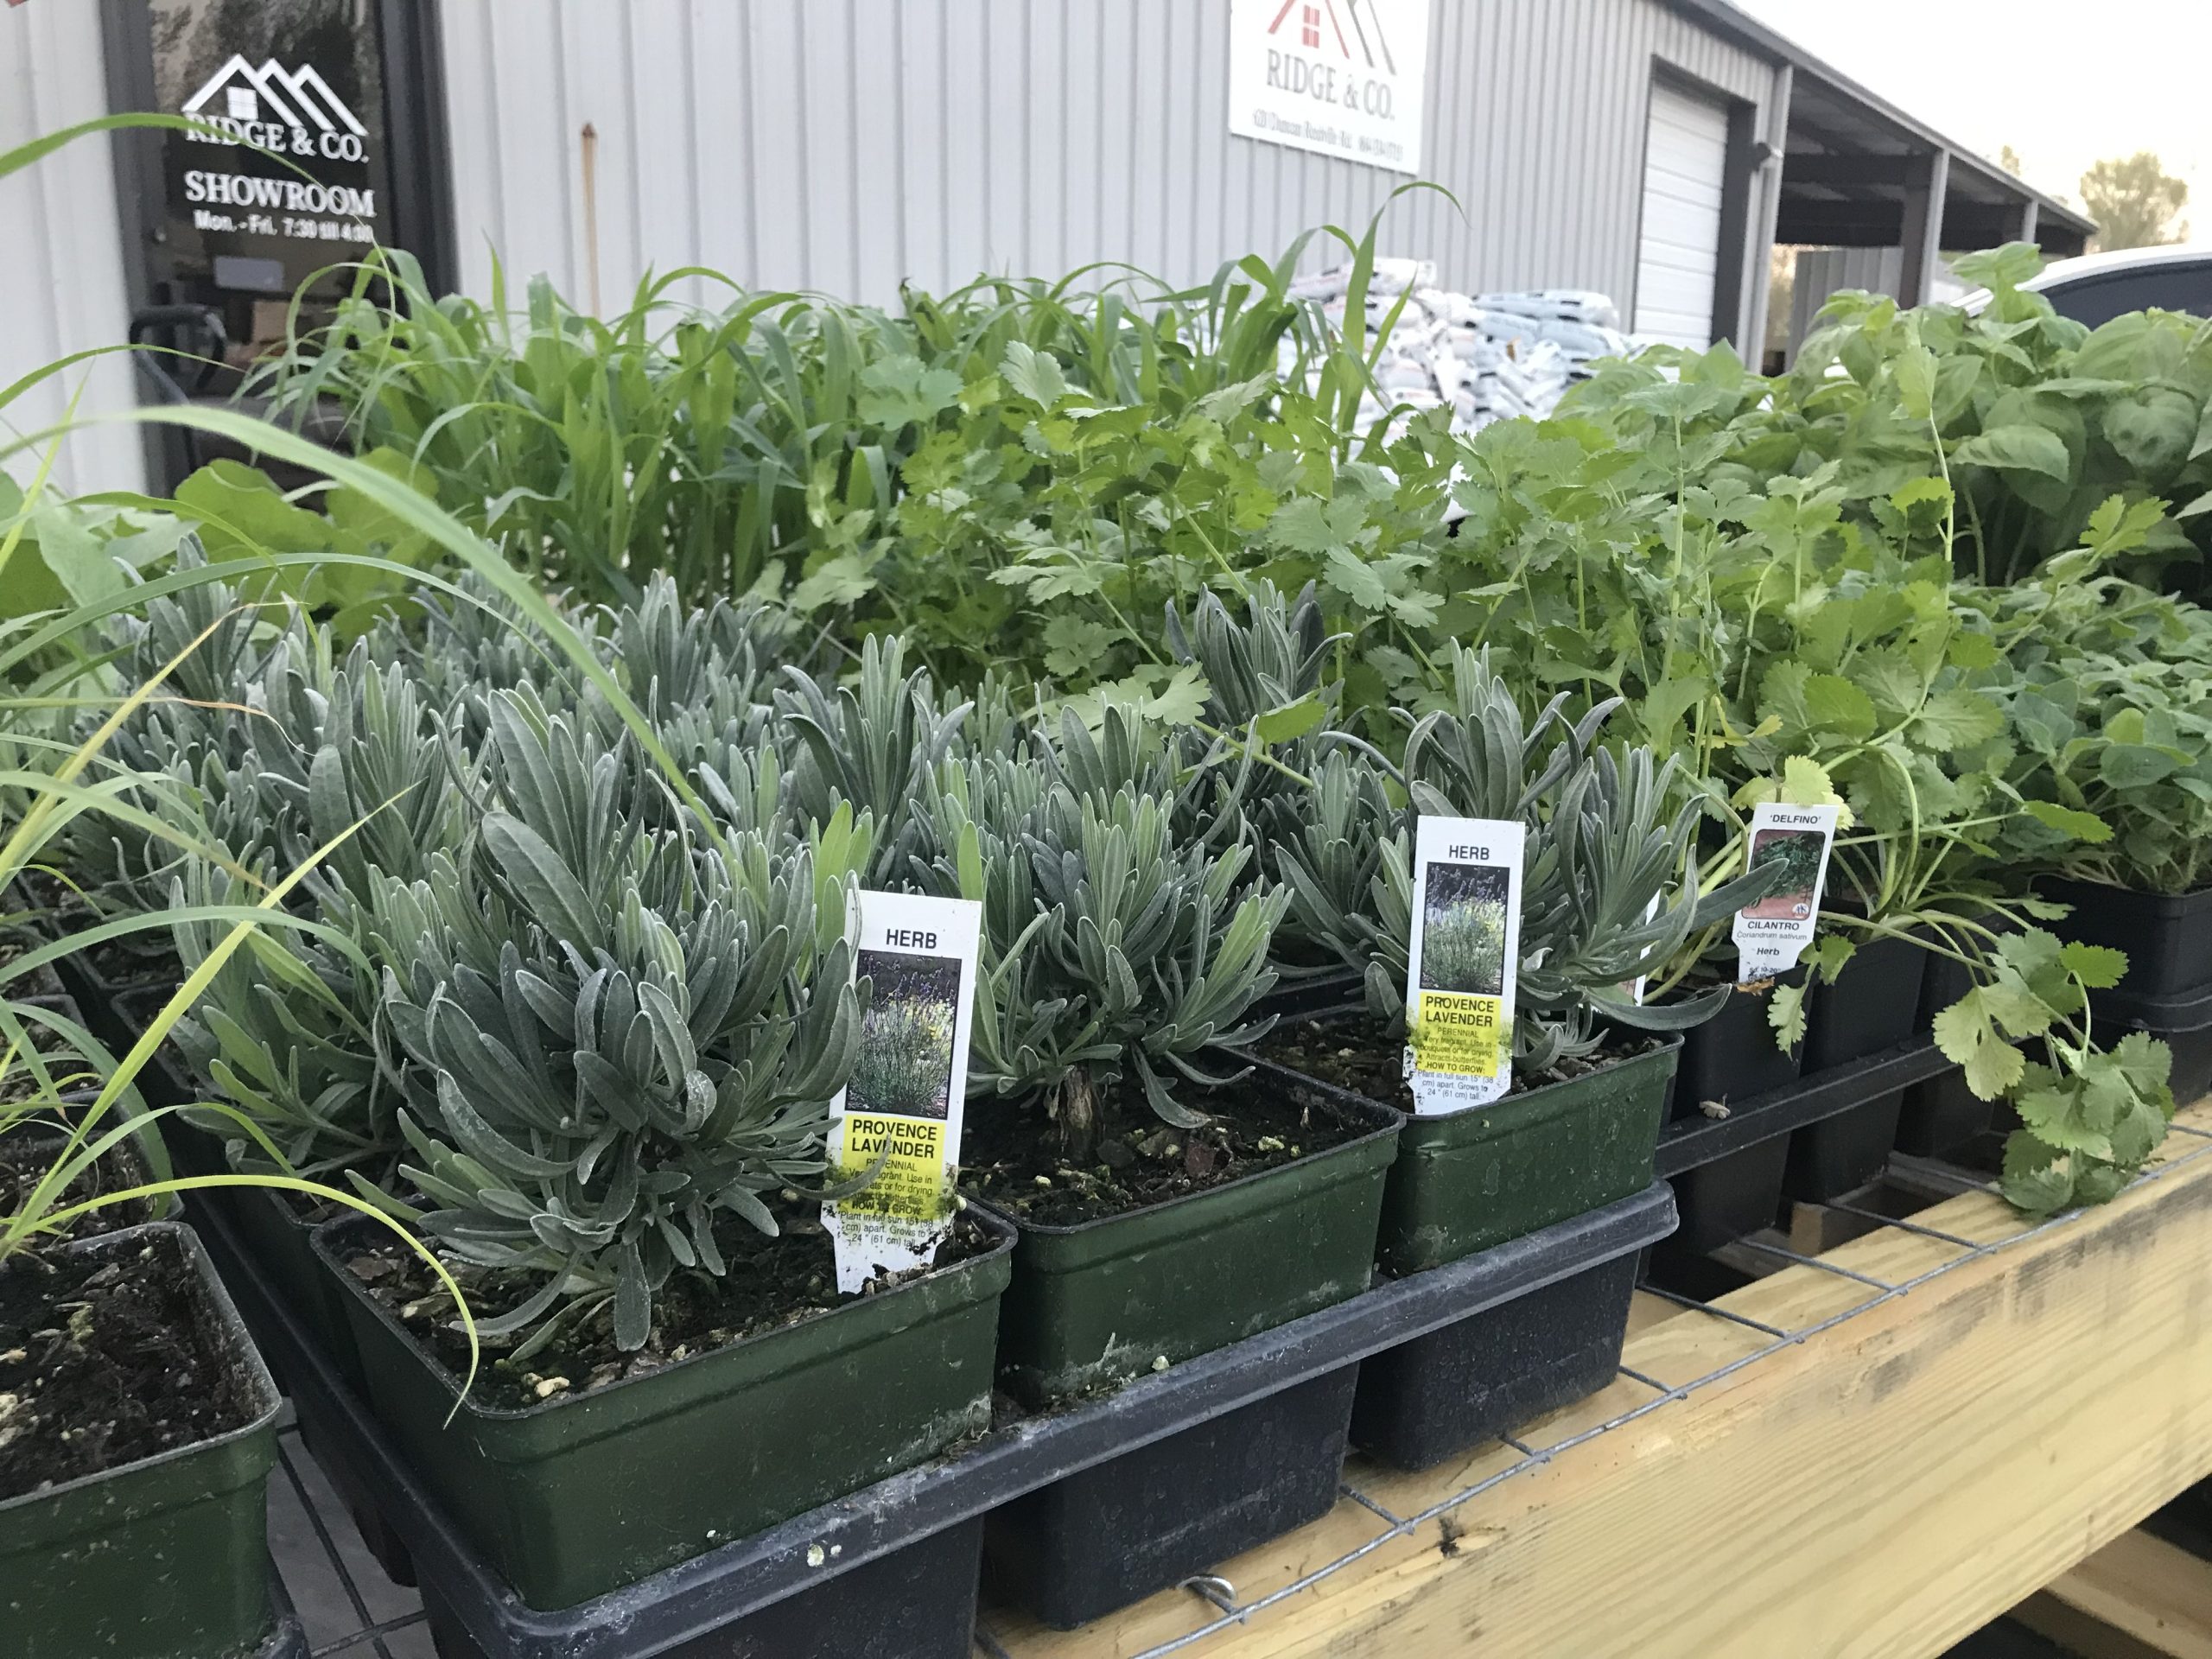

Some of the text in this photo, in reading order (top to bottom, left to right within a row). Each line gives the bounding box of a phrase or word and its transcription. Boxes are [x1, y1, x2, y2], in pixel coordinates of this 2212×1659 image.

[1267, 48, 1395, 121] RIDGE & CO.
[184, 112, 370, 163] RIDGE & CO.
[184, 170, 377, 217] SHOWROOM
[1449, 844, 1490, 861] HERB
[1747, 921, 1800, 931] CILANTRO
[886, 929, 937, 949] HERB
[1757, 947, 1780, 956] Herb
[1426, 995, 1494, 1013] PROVENCE
[1426, 1010, 1493, 1027] LAVENDER
[1437, 1027, 1478, 1038] PERENNIAL
[1427, 1061, 1485, 1074] HOW TO GROW:
[1444, 1071, 1454, 1080] full
[1483, 1075, 1494, 1084] (38
[1422, 1079, 1434, 1089] cm)
[1458, 1082, 1479, 1091] Grows
[1442, 1089, 1452, 1098] (61
[1454, 1090, 1467, 1100] cm)
[852, 1119, 938, 1141] PROVENCE
[866, 1158, 917, 1172] PEENNIAL
[906, 1173, 923, 1183] Use
[925, 1175, 932, 1185] in
[895, 1182, 906, 1192] for
[840, 1211, 861, 1220] Plant
[864, 1212, 871, 1221] in
[887, 1215, 901, 1224] sun
[846, 1223, 861, 1233] cm)
[890, 1226, 916, 1236] Grows
[852, 1233, 861, 1242] 24
[871, 1234, 883, 1244] (61
[887, 1236, 901, 1247] cm)
